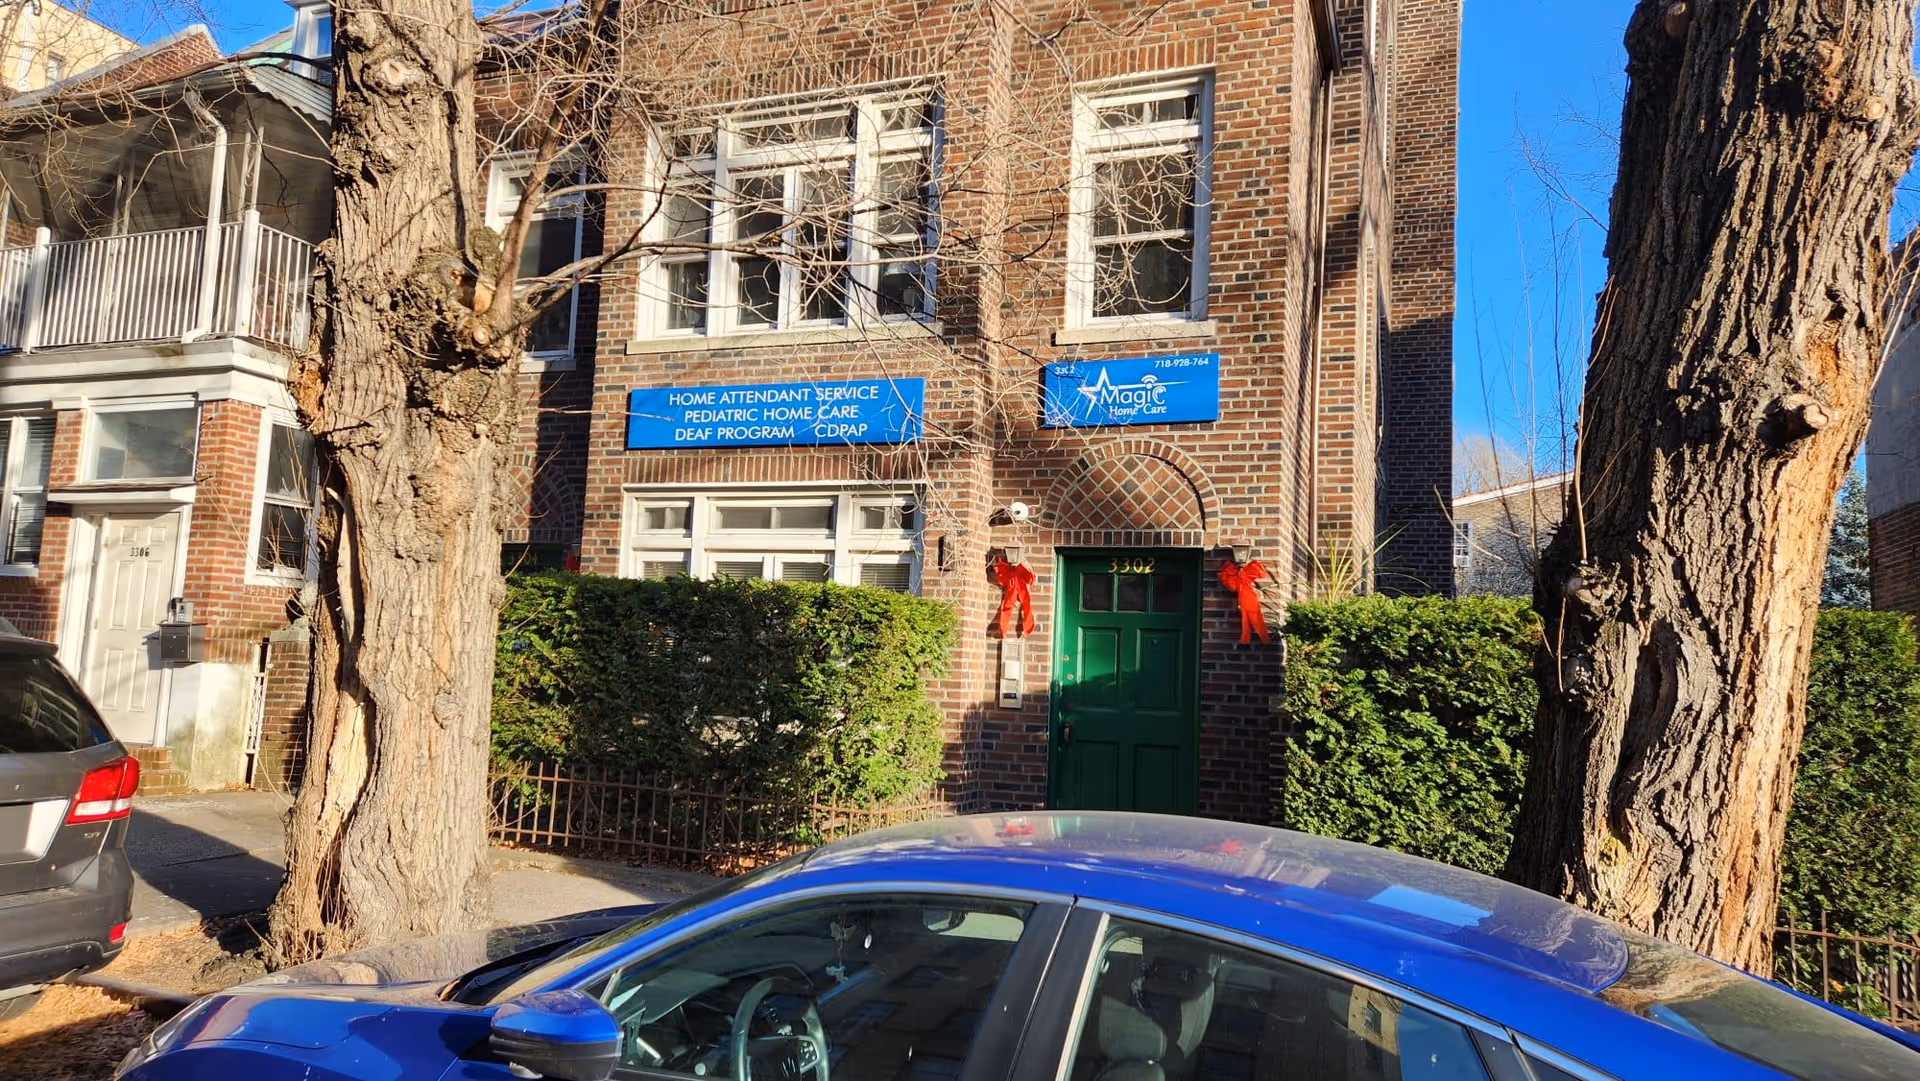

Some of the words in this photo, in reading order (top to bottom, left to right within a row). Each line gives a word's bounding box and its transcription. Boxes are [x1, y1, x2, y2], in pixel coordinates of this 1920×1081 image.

[1154, 357, 1210, 369] 718-928-764
[669, 392, 716, 406] HOME
[719, 387, 811, 405] ATTENDANT
[815, 385, 879, 401] SERVICE
[684, 407, 759, 424] PEDIATRIC
[763, 406, 813, 421] HOME
[817, 405, 860, 420] CARE
[1109, 405, 1139, 417] Home
[1143, 403, 1168, 415] Care
[675, 427, 714, 441] DEAF
[717, 425, 795, 441] PROGRAM
[815, 423, 868, 438] CDPAP
[1108, 557, 1155, 574] 3302
